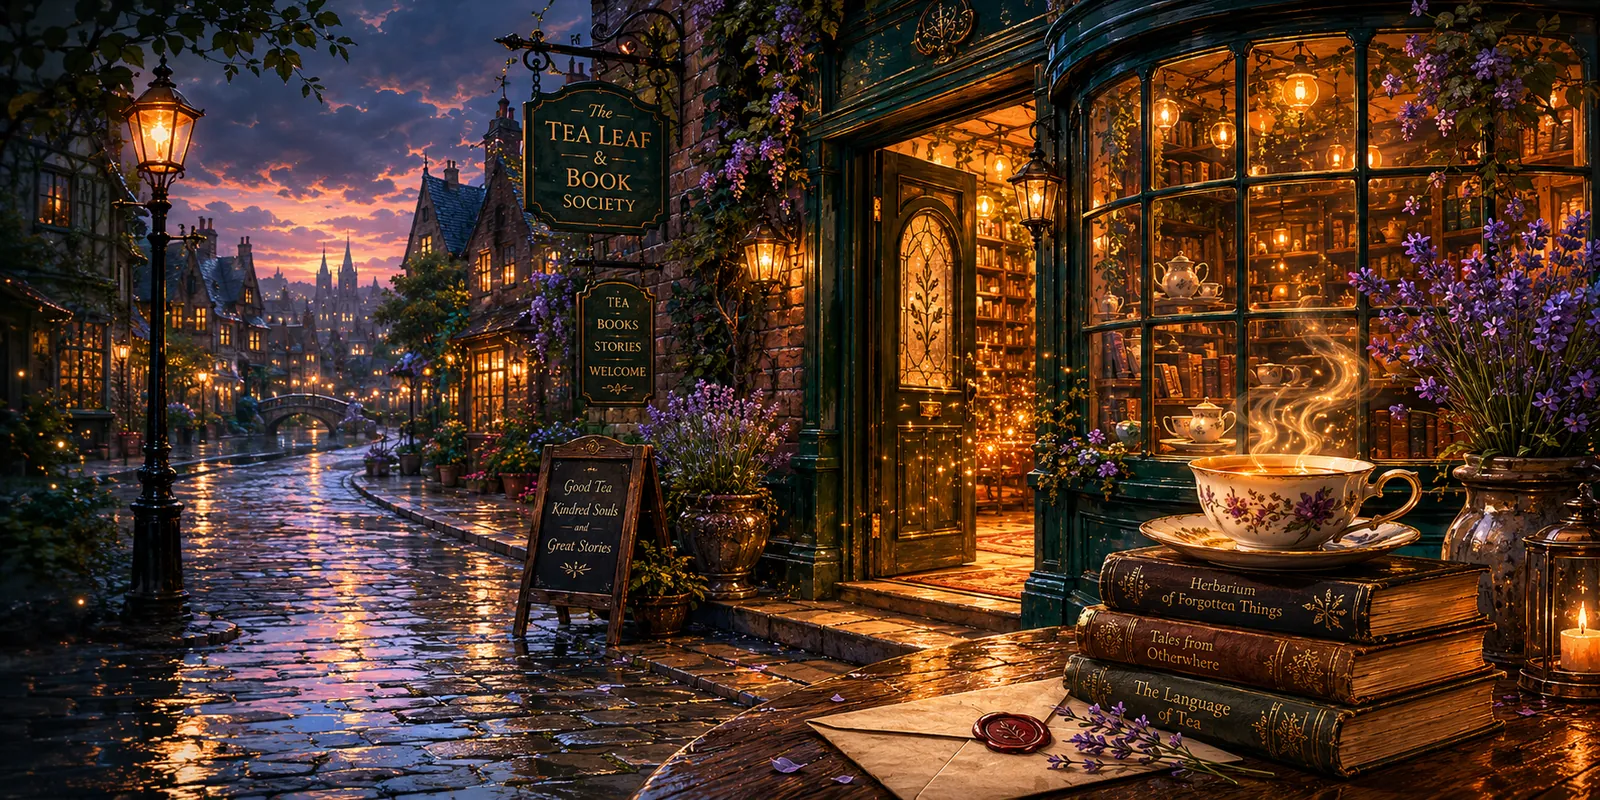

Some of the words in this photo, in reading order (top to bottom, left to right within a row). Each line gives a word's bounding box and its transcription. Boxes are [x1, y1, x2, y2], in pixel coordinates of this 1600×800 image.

[588, 103, 613, 119] The
[544, 120, 592, 144] TEA
[598, 125, 652, 149] LEAF
[593, 150, 608, 166] &
[566, 167, 632, 192] BOOK
[563, 193, 636, 213] SOCIETY
[606, 296, 630, 309] TEA
[597, 318, 639, 330] BOOKS
[594, 341, 642, 353] STORIES
[589, 365, 647, 377] WELCOME
[564, 479, 592, 496] Good
[594, 480, 613, 493] Tea
[551, 501, 592, 517] Kindred
[592, 503, 619, 517] Souls
[574, 522, 590, 532] and
[547, 537, 576, 554] Great
[577, 539, 612, 554] Stories
[1190, 576, 1256, 596] Herbarium
[1161, 591, 1176, 607] of
[1178, 592, 1236, 611] Forgotten
[1239, 599, 1283, 619] Things
[1150, 629, 1181, 646] Tales
[1182, 635, 1214, 652] from
[1147, 646, 1220, 671] Otherwhere
[1134, 679, 1160, 699] The
[1163, 686, 1231, 718] Language
[1158, 707, 1173, 725] of
[1176, 710, 1202, 730] Tea
